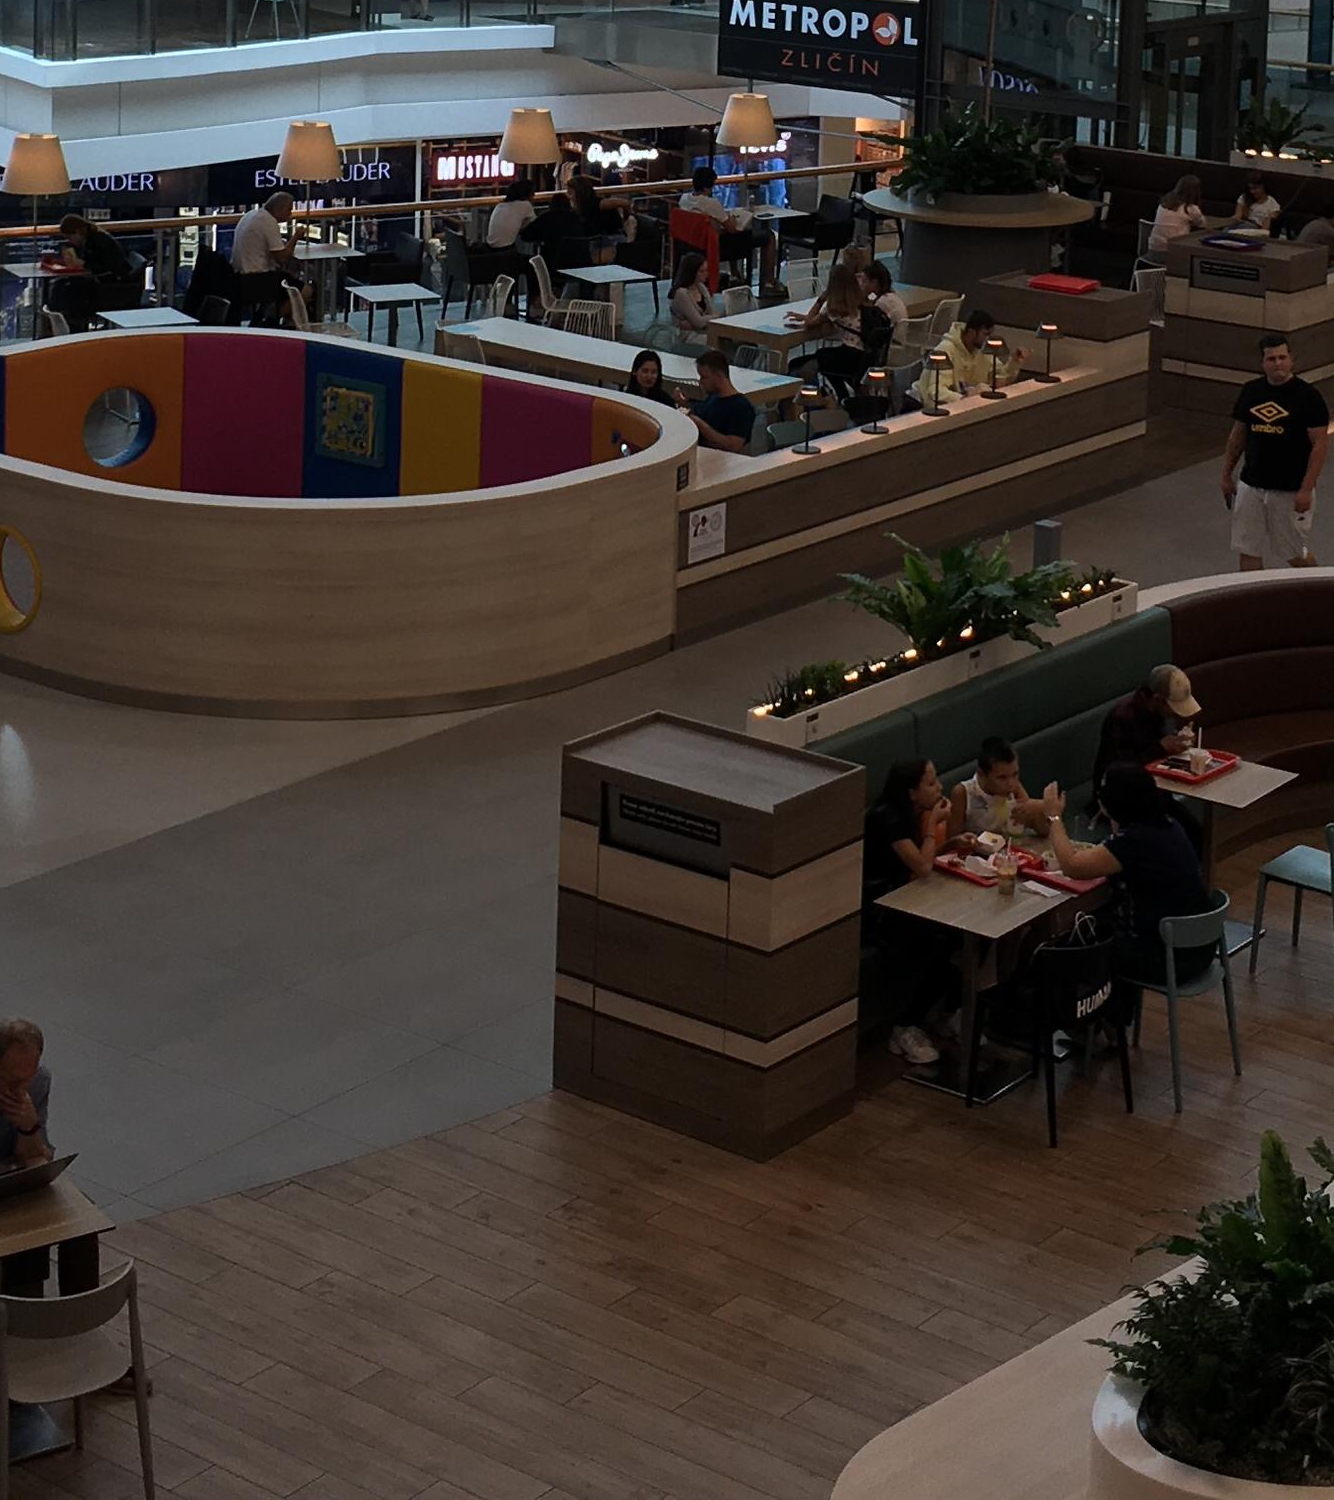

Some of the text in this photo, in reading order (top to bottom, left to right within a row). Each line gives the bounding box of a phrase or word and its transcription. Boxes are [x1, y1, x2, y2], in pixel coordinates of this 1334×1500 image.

[780, 48, 880, 77] ZLIČÍN
[316, 162, 391, 184] UDER
[437, 155, 515, 181] MUSTANG
[1251, 423, 1284, 435] umbro
